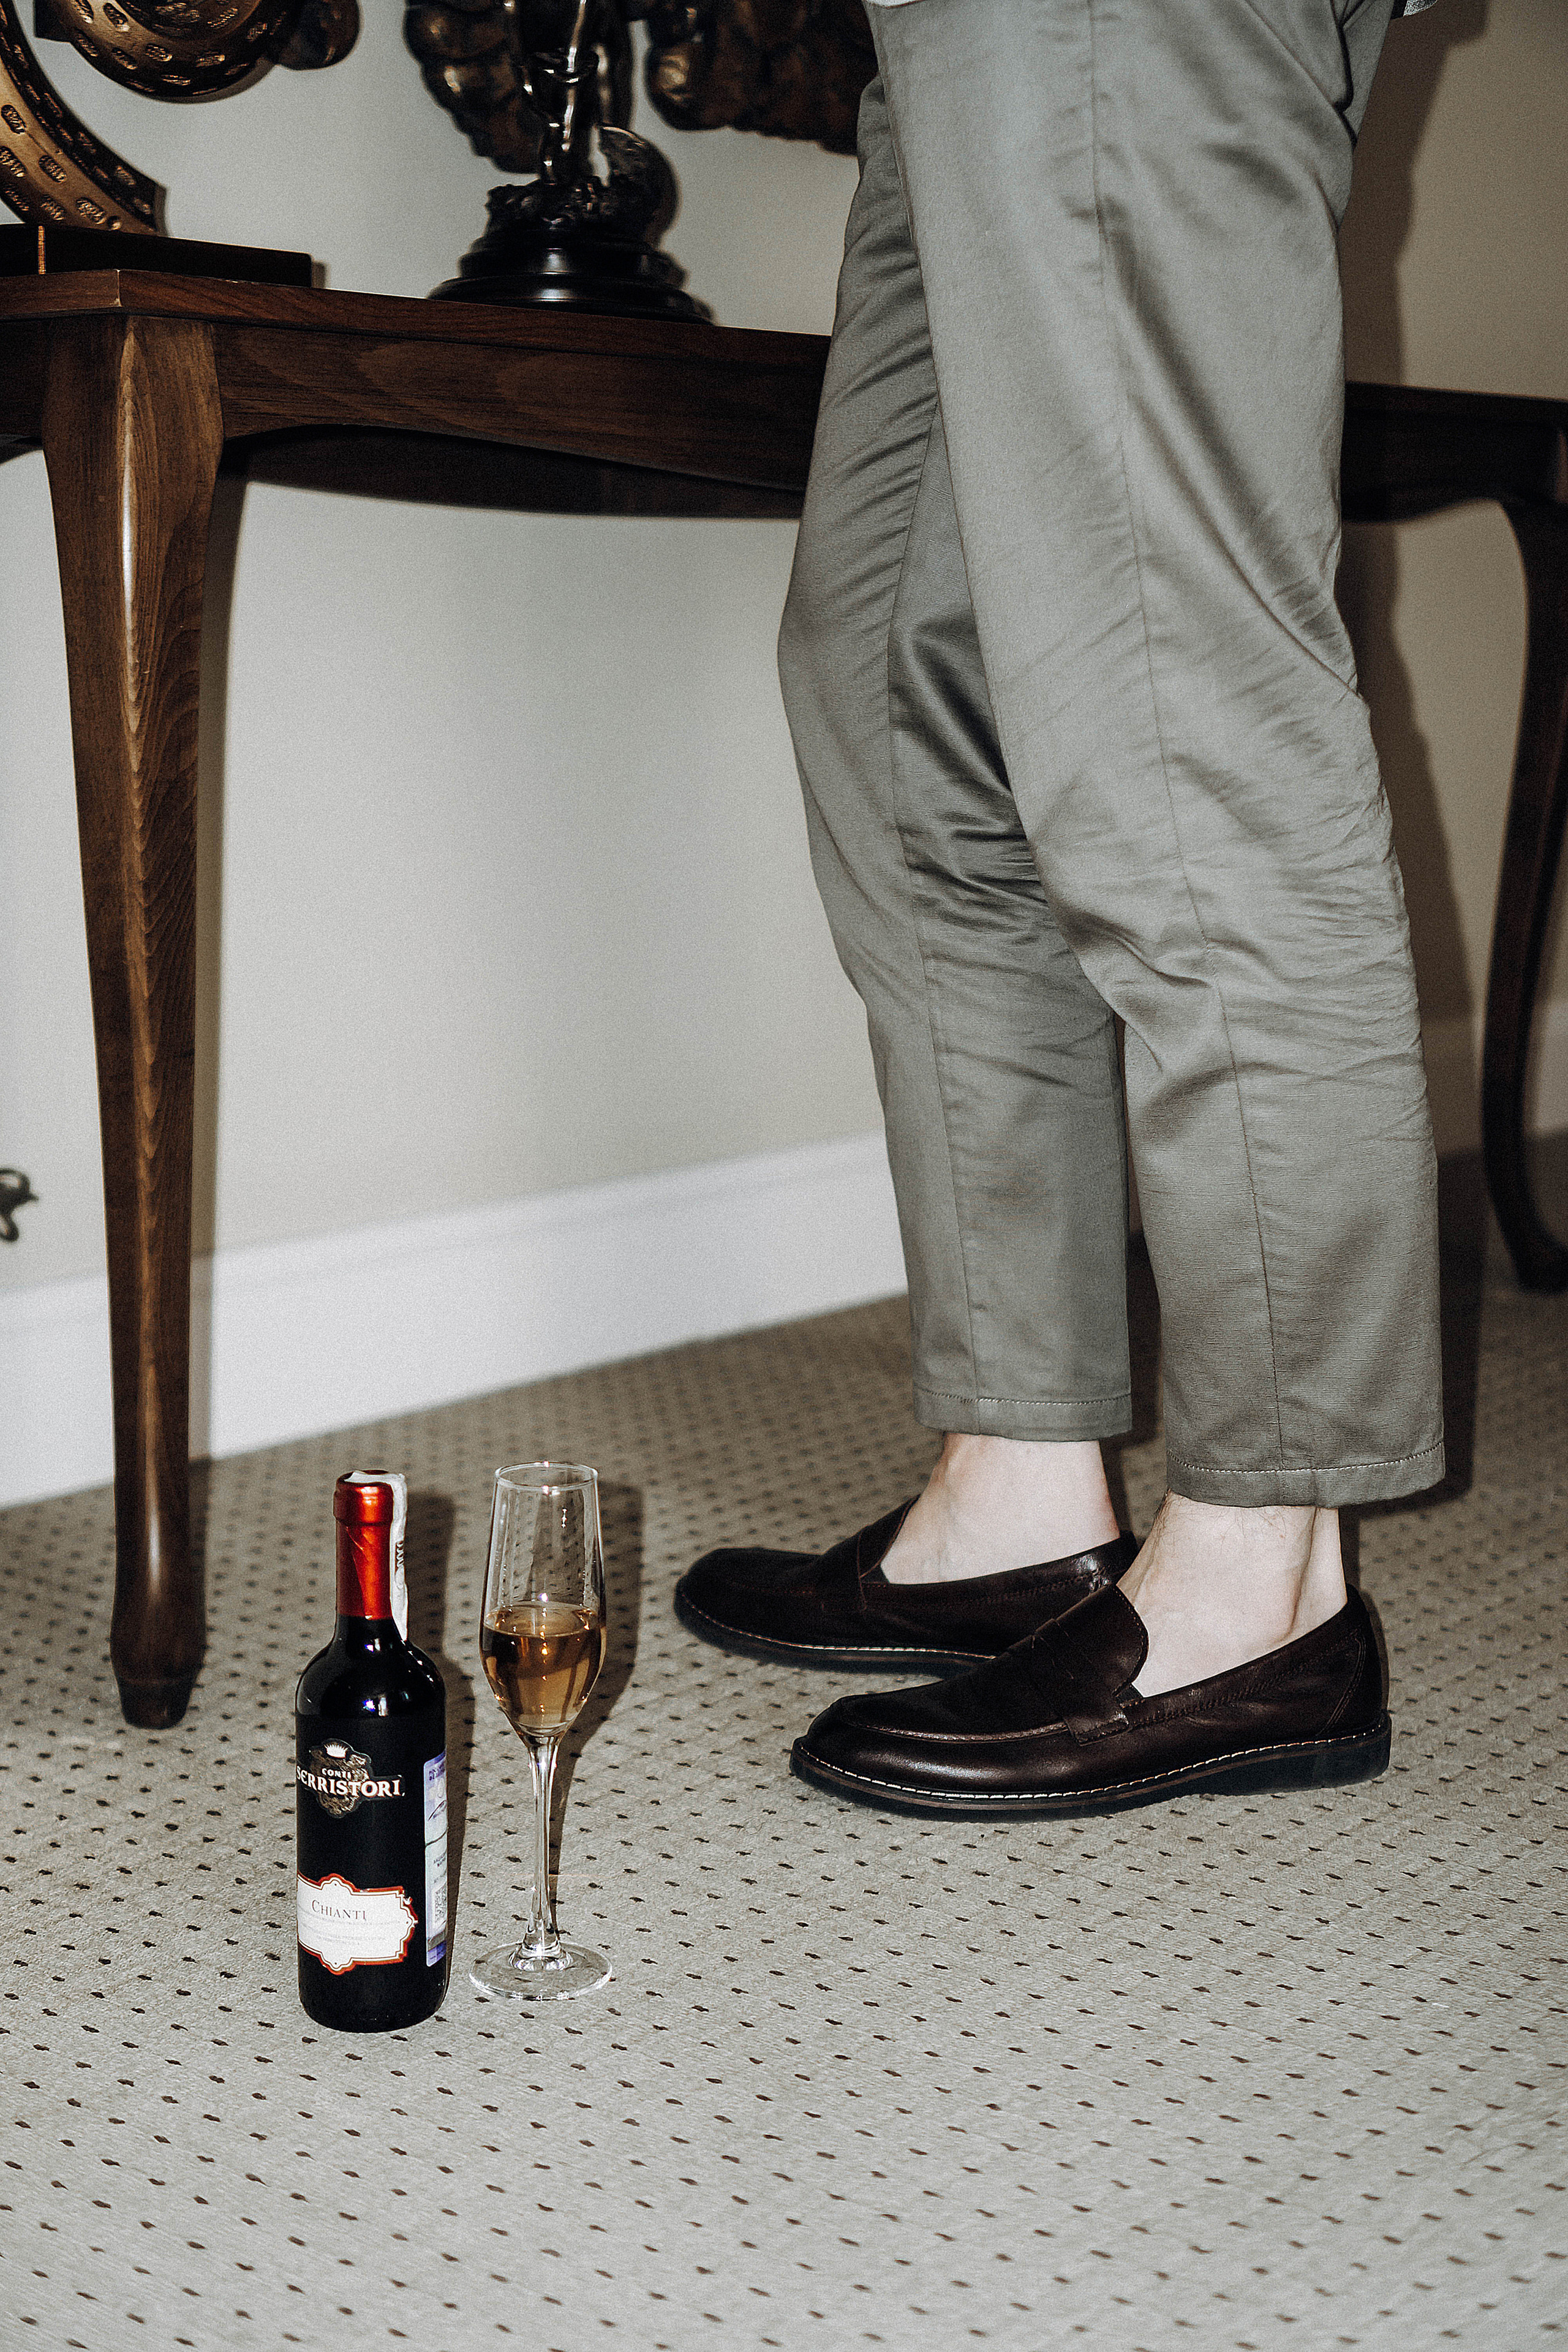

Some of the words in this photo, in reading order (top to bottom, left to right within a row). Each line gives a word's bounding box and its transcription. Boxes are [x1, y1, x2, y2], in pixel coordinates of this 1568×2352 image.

[296, 1766, 401, 1798] SERRISTORI
[322, 1768, 352, 1779] CONTI
[312, 1899, 366, 1920] CHIANTI
